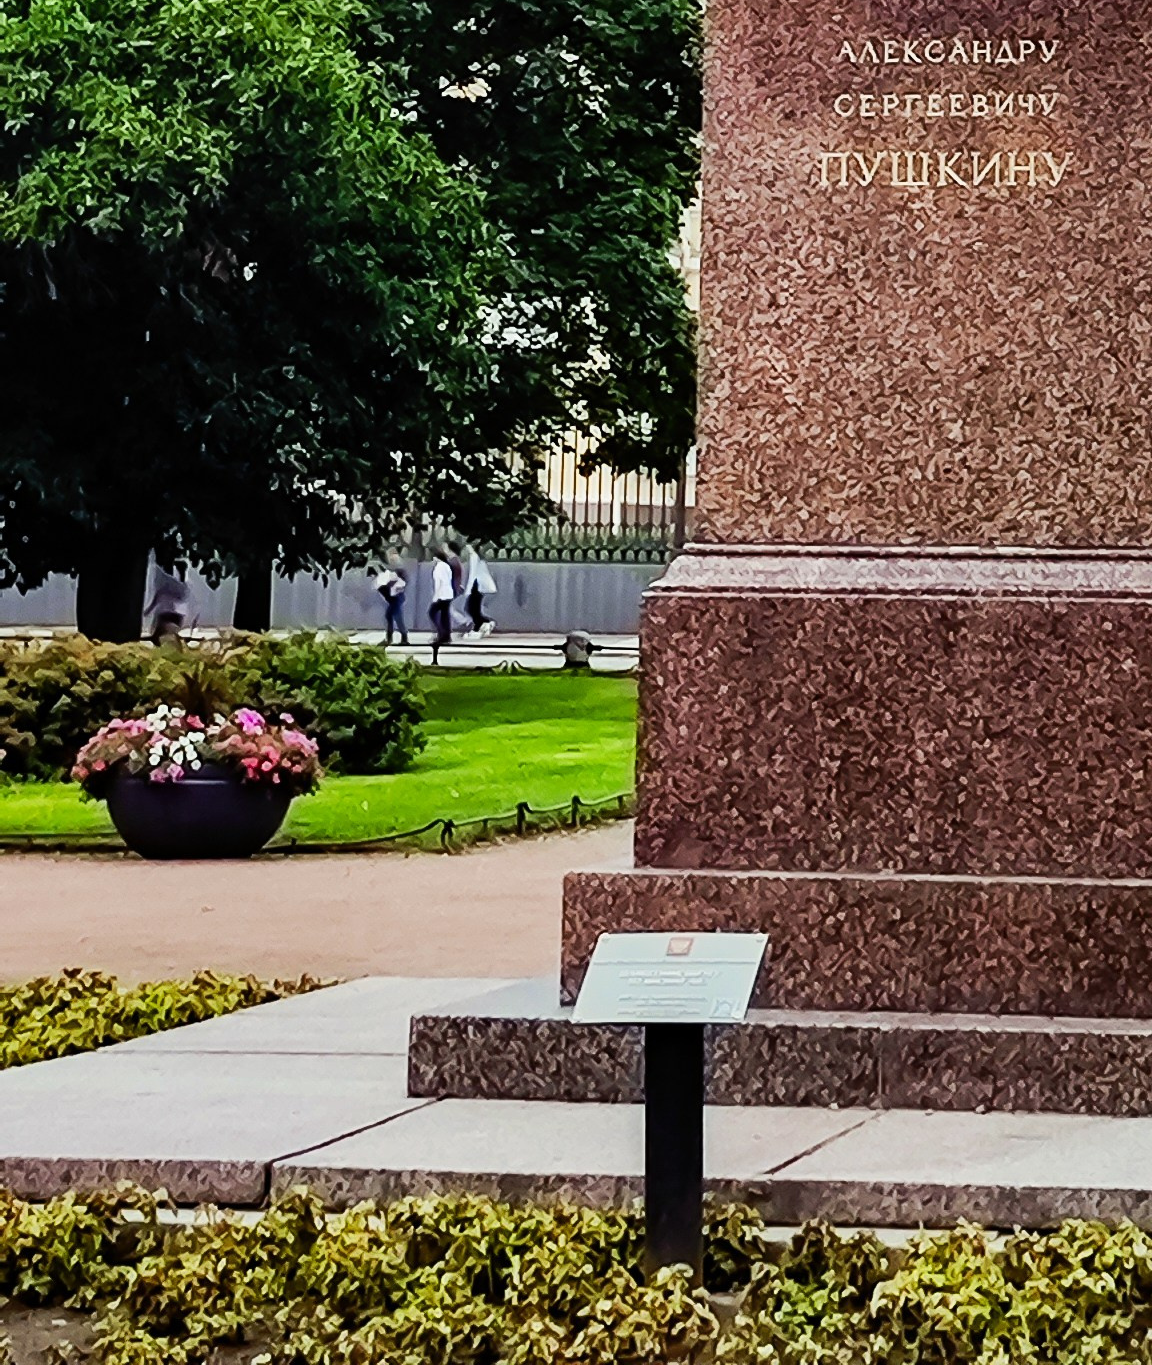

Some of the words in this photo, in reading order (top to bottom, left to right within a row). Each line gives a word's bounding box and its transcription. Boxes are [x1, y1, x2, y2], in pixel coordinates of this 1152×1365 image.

[837, 39, 1060, 64] АЛЕКСАНДРУ
[833, 92, 1060, 118] СЕРГЕЕВИЧУ
[819, 150, 1073, 188] ПУШКИНУ
